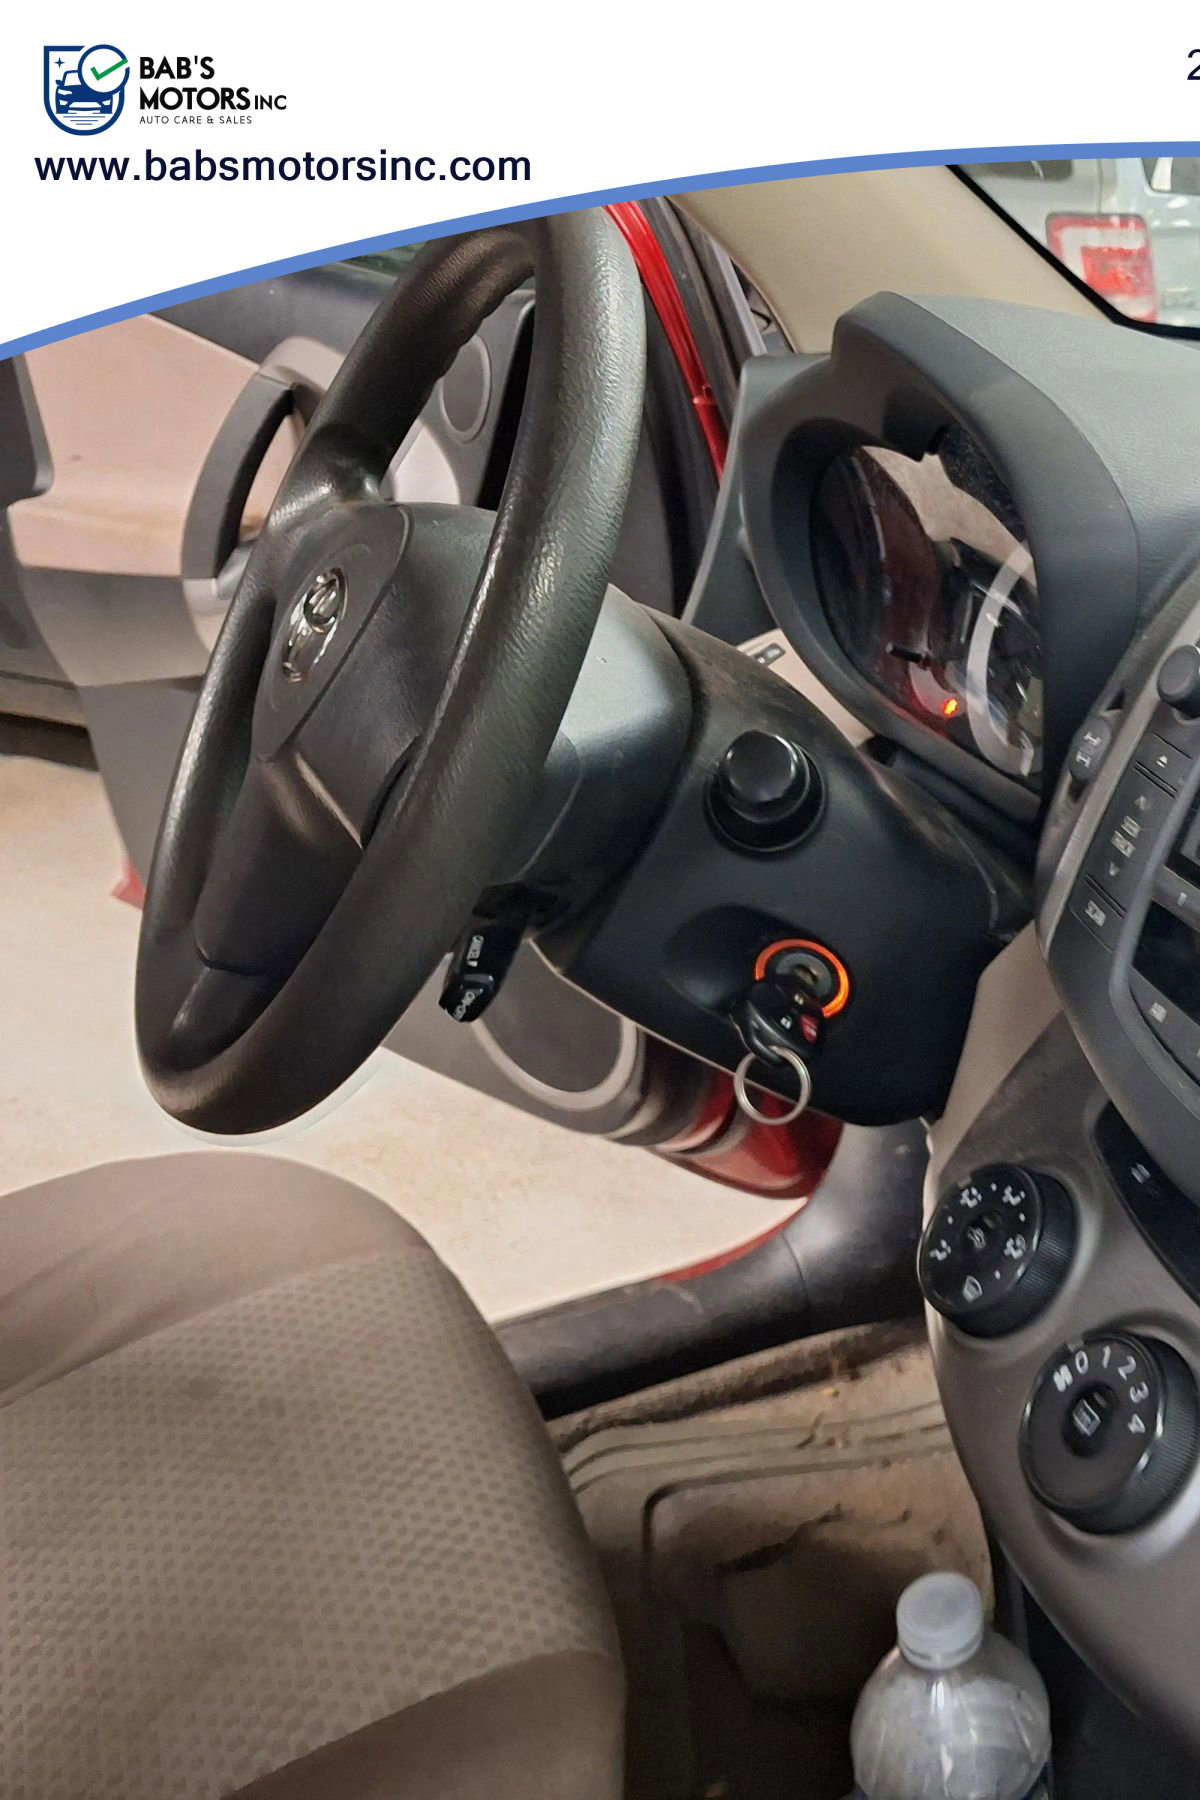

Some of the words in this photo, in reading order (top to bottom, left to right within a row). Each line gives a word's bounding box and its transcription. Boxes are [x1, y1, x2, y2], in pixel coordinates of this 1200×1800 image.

[1102, 1345, 1111, 1369] 1
[1117, 1355, 1137, 1381] 2
[1129, 1381, 1150, 1404] 3
[1127, 1413, 1146, 1435] 4
